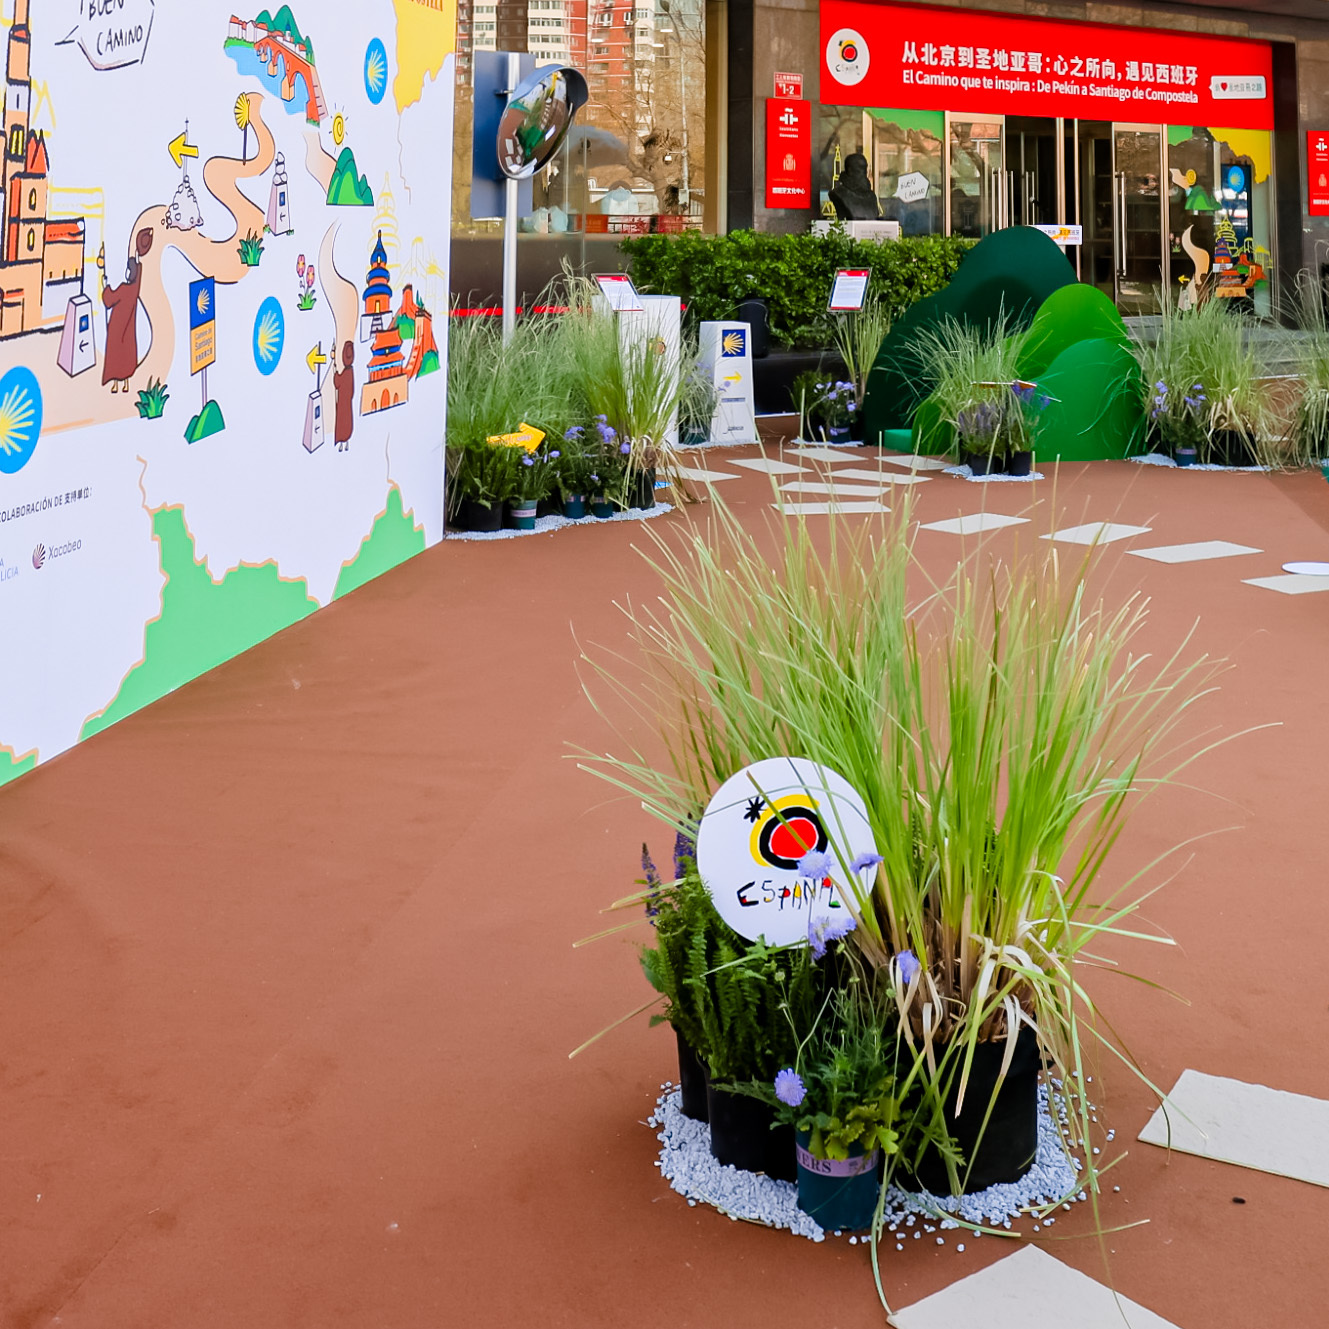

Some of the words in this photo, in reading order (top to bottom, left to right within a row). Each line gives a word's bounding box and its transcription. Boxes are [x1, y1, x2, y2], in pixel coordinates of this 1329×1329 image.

[97, 25, 143, 56] CAMINO
[903, 69, 913, 84] El
[915, 71, 959, 87] Camino
[960, 76, 981, 90] que
[983, 77, 993, 89] te
[1037, 80, 1051, 93] De
[1052, 80, 1080, 96] Pekín
[1081, 85, 1088, 96] a
[1089, 83, 1131, 101] Santiago
[1132, 86, 1144, 98] de
[1145, 88, 1199, 104] Compostela
[54, 495, 63, 508] DE
